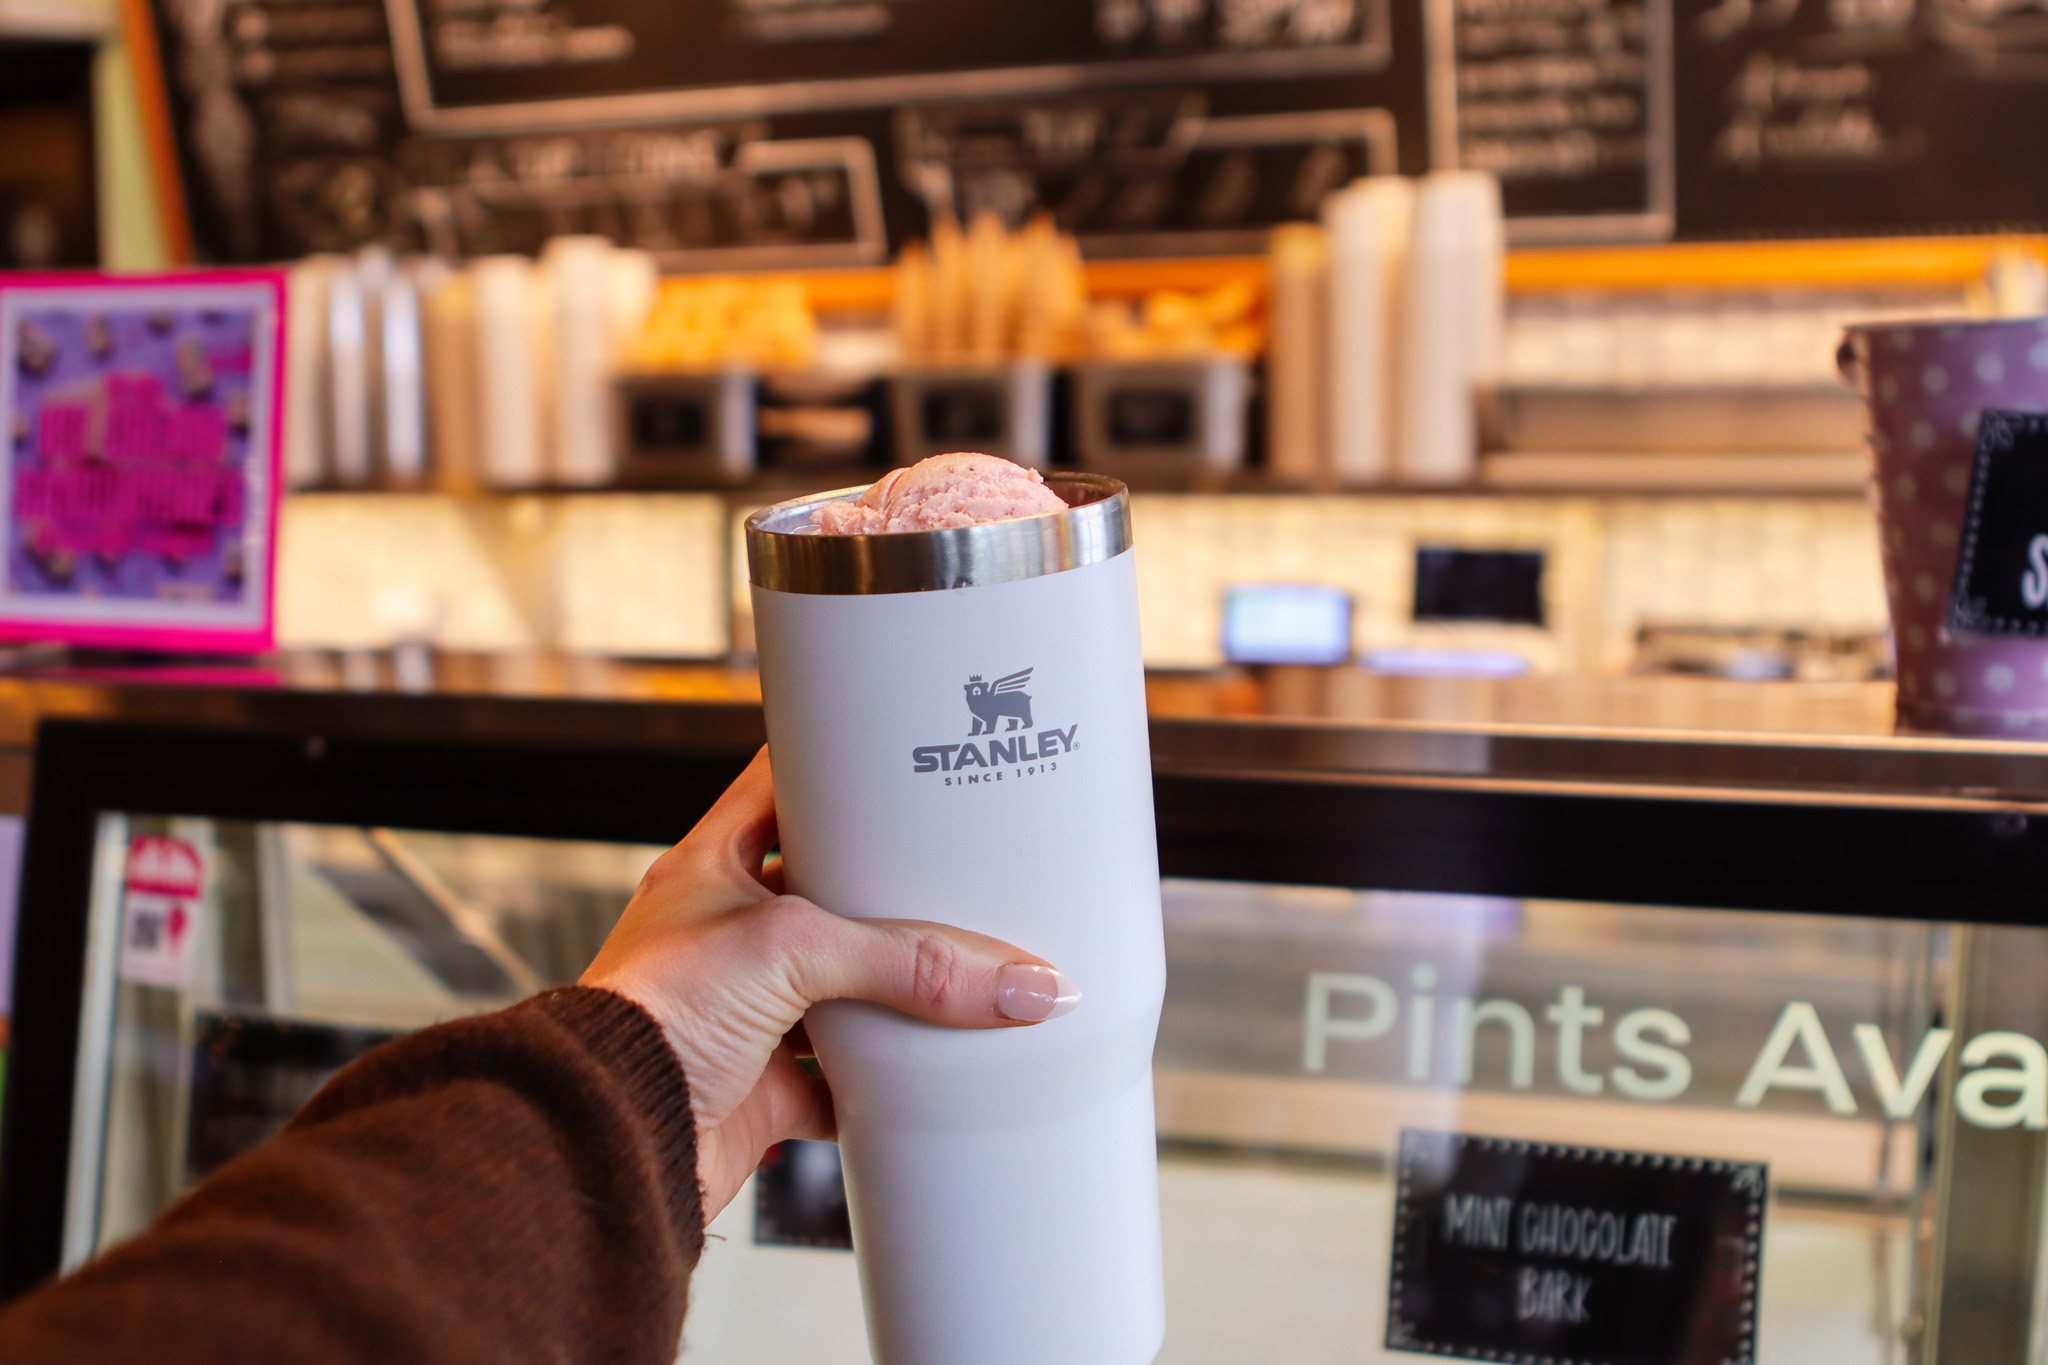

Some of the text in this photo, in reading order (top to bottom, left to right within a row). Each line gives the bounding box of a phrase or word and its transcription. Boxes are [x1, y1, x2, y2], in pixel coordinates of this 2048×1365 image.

[912, 724, 1078, 773] STANLEY
[944, 762, 1058, 786] SINCE 1913
[1303, 963, 2048, 1131] Pints Ava
[1443, 1193, 1678, 1269] MINT CHOCOLATE
[1516, 1265, 1593, 1325] BARK
